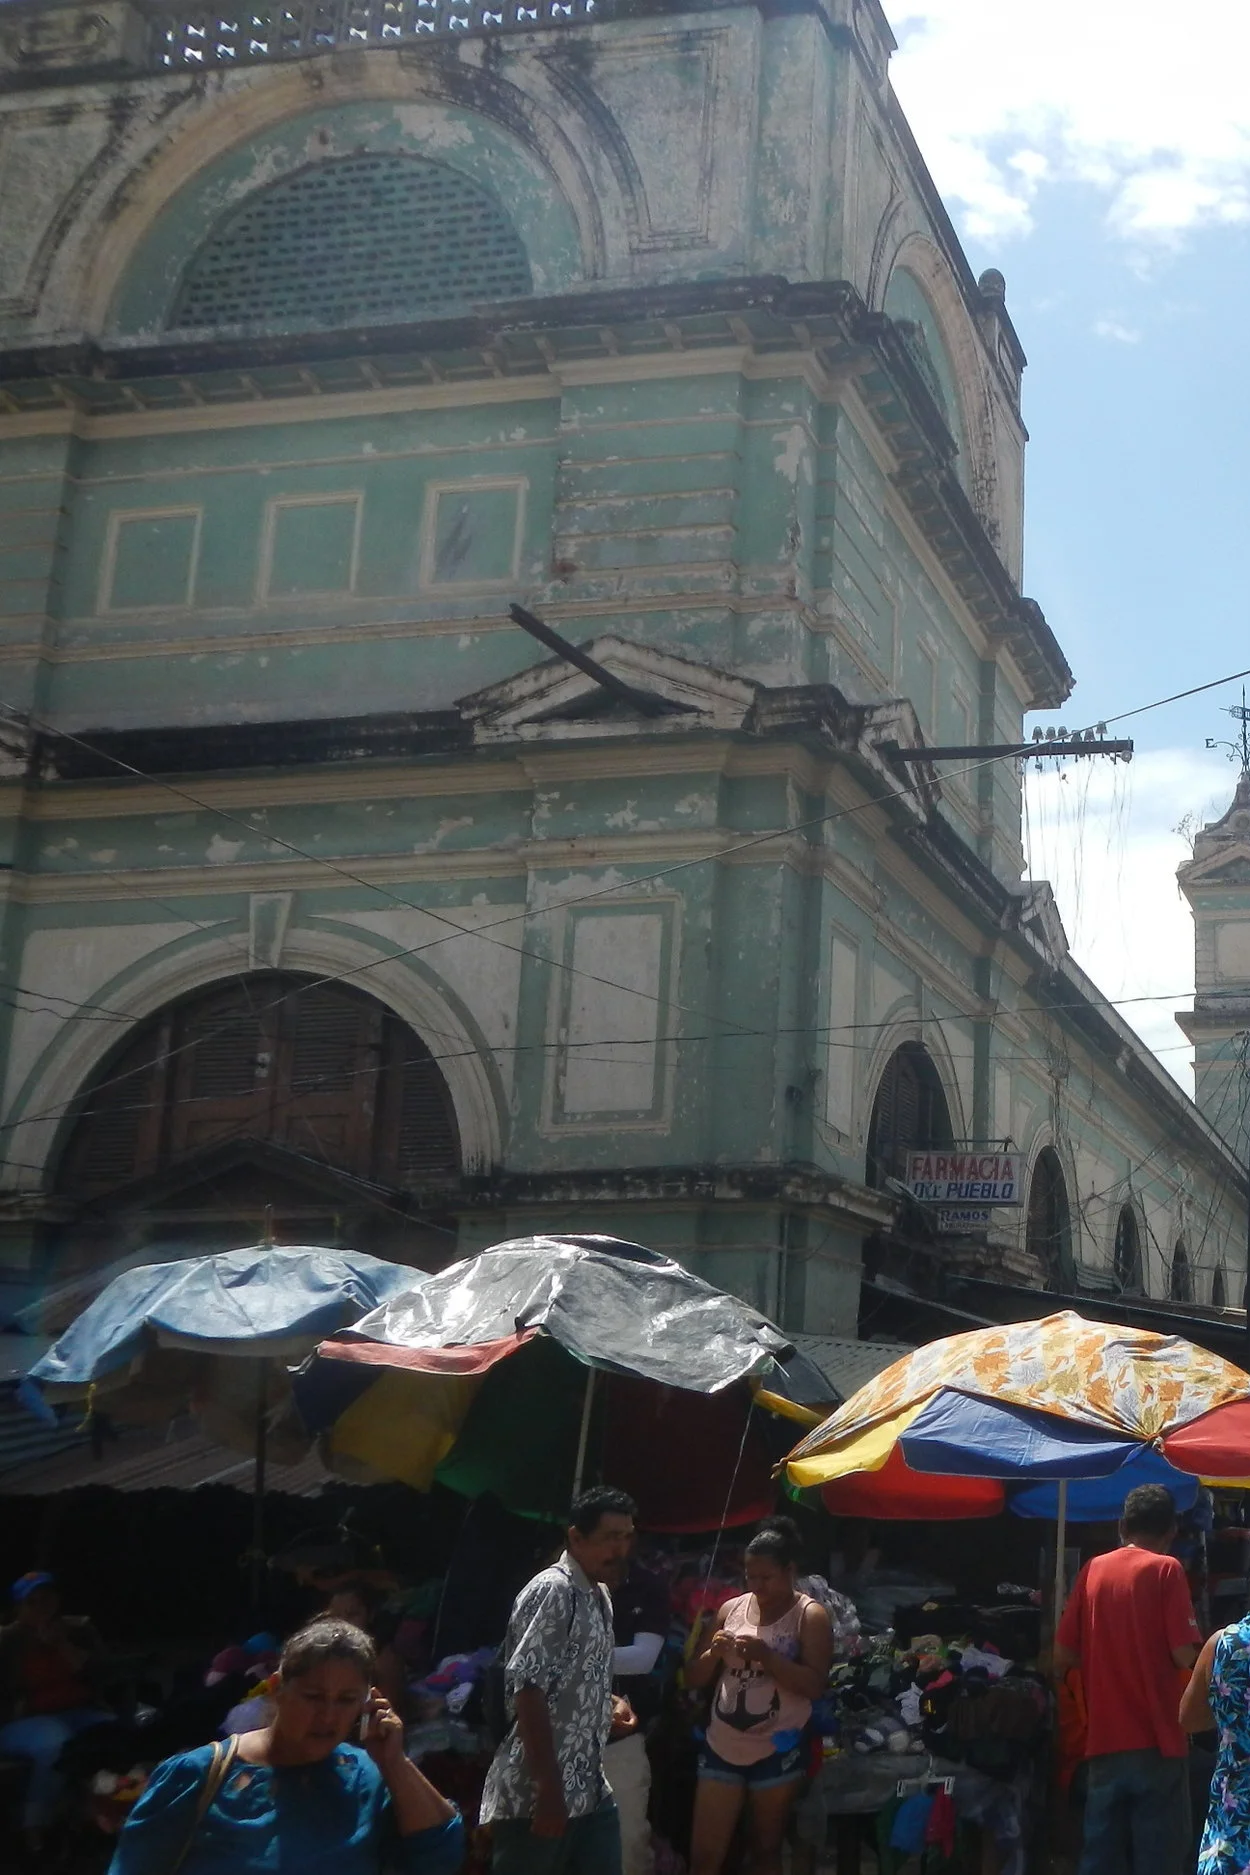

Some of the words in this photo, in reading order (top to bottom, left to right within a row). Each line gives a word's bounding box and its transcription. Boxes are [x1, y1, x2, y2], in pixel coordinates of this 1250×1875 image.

[912, 1156, 1013, 1180] FARMACIA
[946, 1183, 1014, 1199] PUEBLO
[940, 1210, 989, 1222] RAMOS
